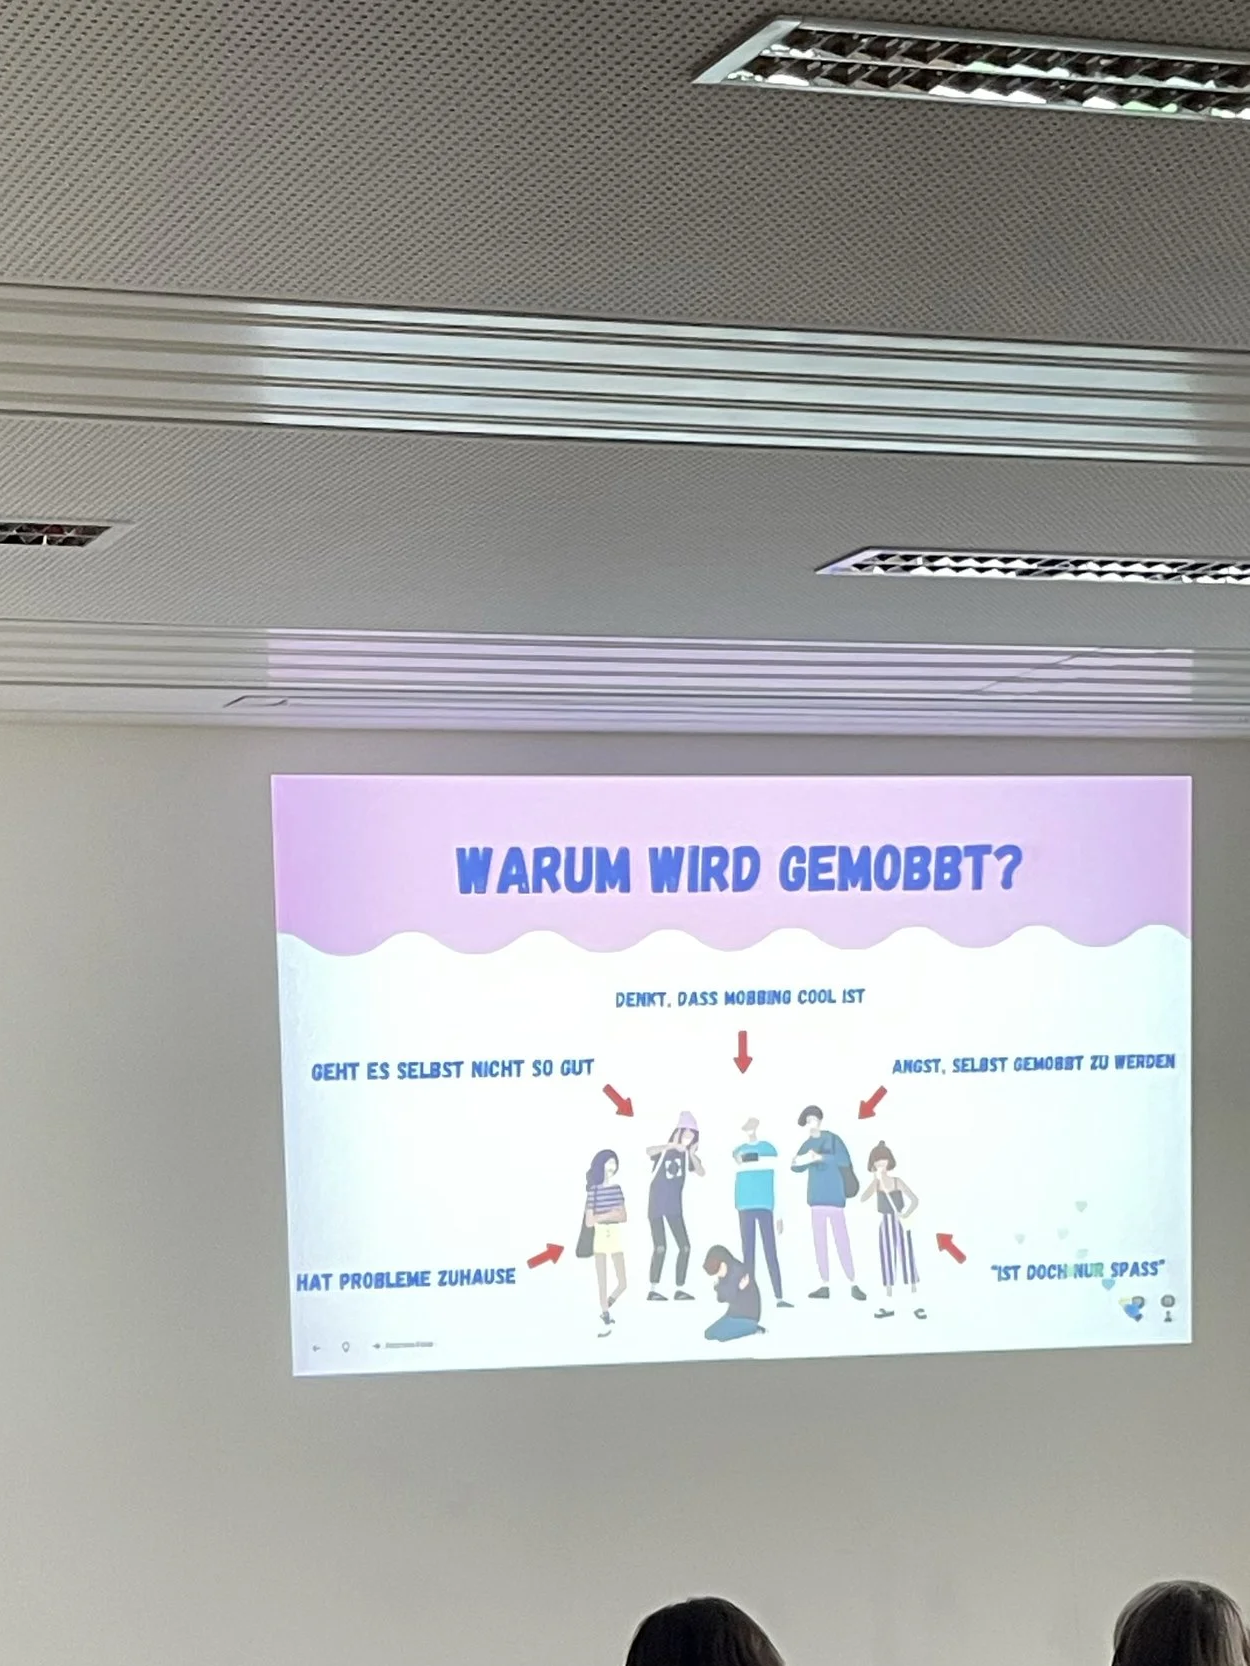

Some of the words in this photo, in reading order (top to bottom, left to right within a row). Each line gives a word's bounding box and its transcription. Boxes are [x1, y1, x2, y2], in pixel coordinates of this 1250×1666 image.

[456, 845, 630, 895] WARUM
[649, 843, 759, 895] WIRD
[778, 842, 1023, 893] GEMOBBT?
[615, 990, 672, 1009] DENKT,
[677, 989, 719, 1009] DASS
[724, 988, 792, 1008] MOBBING
[796, 988, 837, 1006] COOL
[841, 987, 865, 1006] IST
[311, 1060, 361, 1081] GEHT
[366, 1060, 392, 1080] ES
[396, 1059, 465, 1080] SELBST
[471, 1059, 524, 1078] NICHT
[530, 1059, 555, 1077] SO
[559, 1057, 594, 1077] GUT
[892, 1056, 947, 1075] ANGST,
[952, 1056, 1009, 1074] SELBST
[1012, 1054, 1085, 1073] GEMOBBT
[1090, 1054, 1110, 1071] ZU
[1114, 1053, 1175, 1071] WERDEN
[295, 1271, 334, 1291] HAT
[339, 1268, 432, 1290] PROBLEME
[436, 1266, 517, 1287] ZUHAUSE
[1026, 1262, 1068, 1281] DOCH
[1072, 1261, 1106, 1279] NUR
